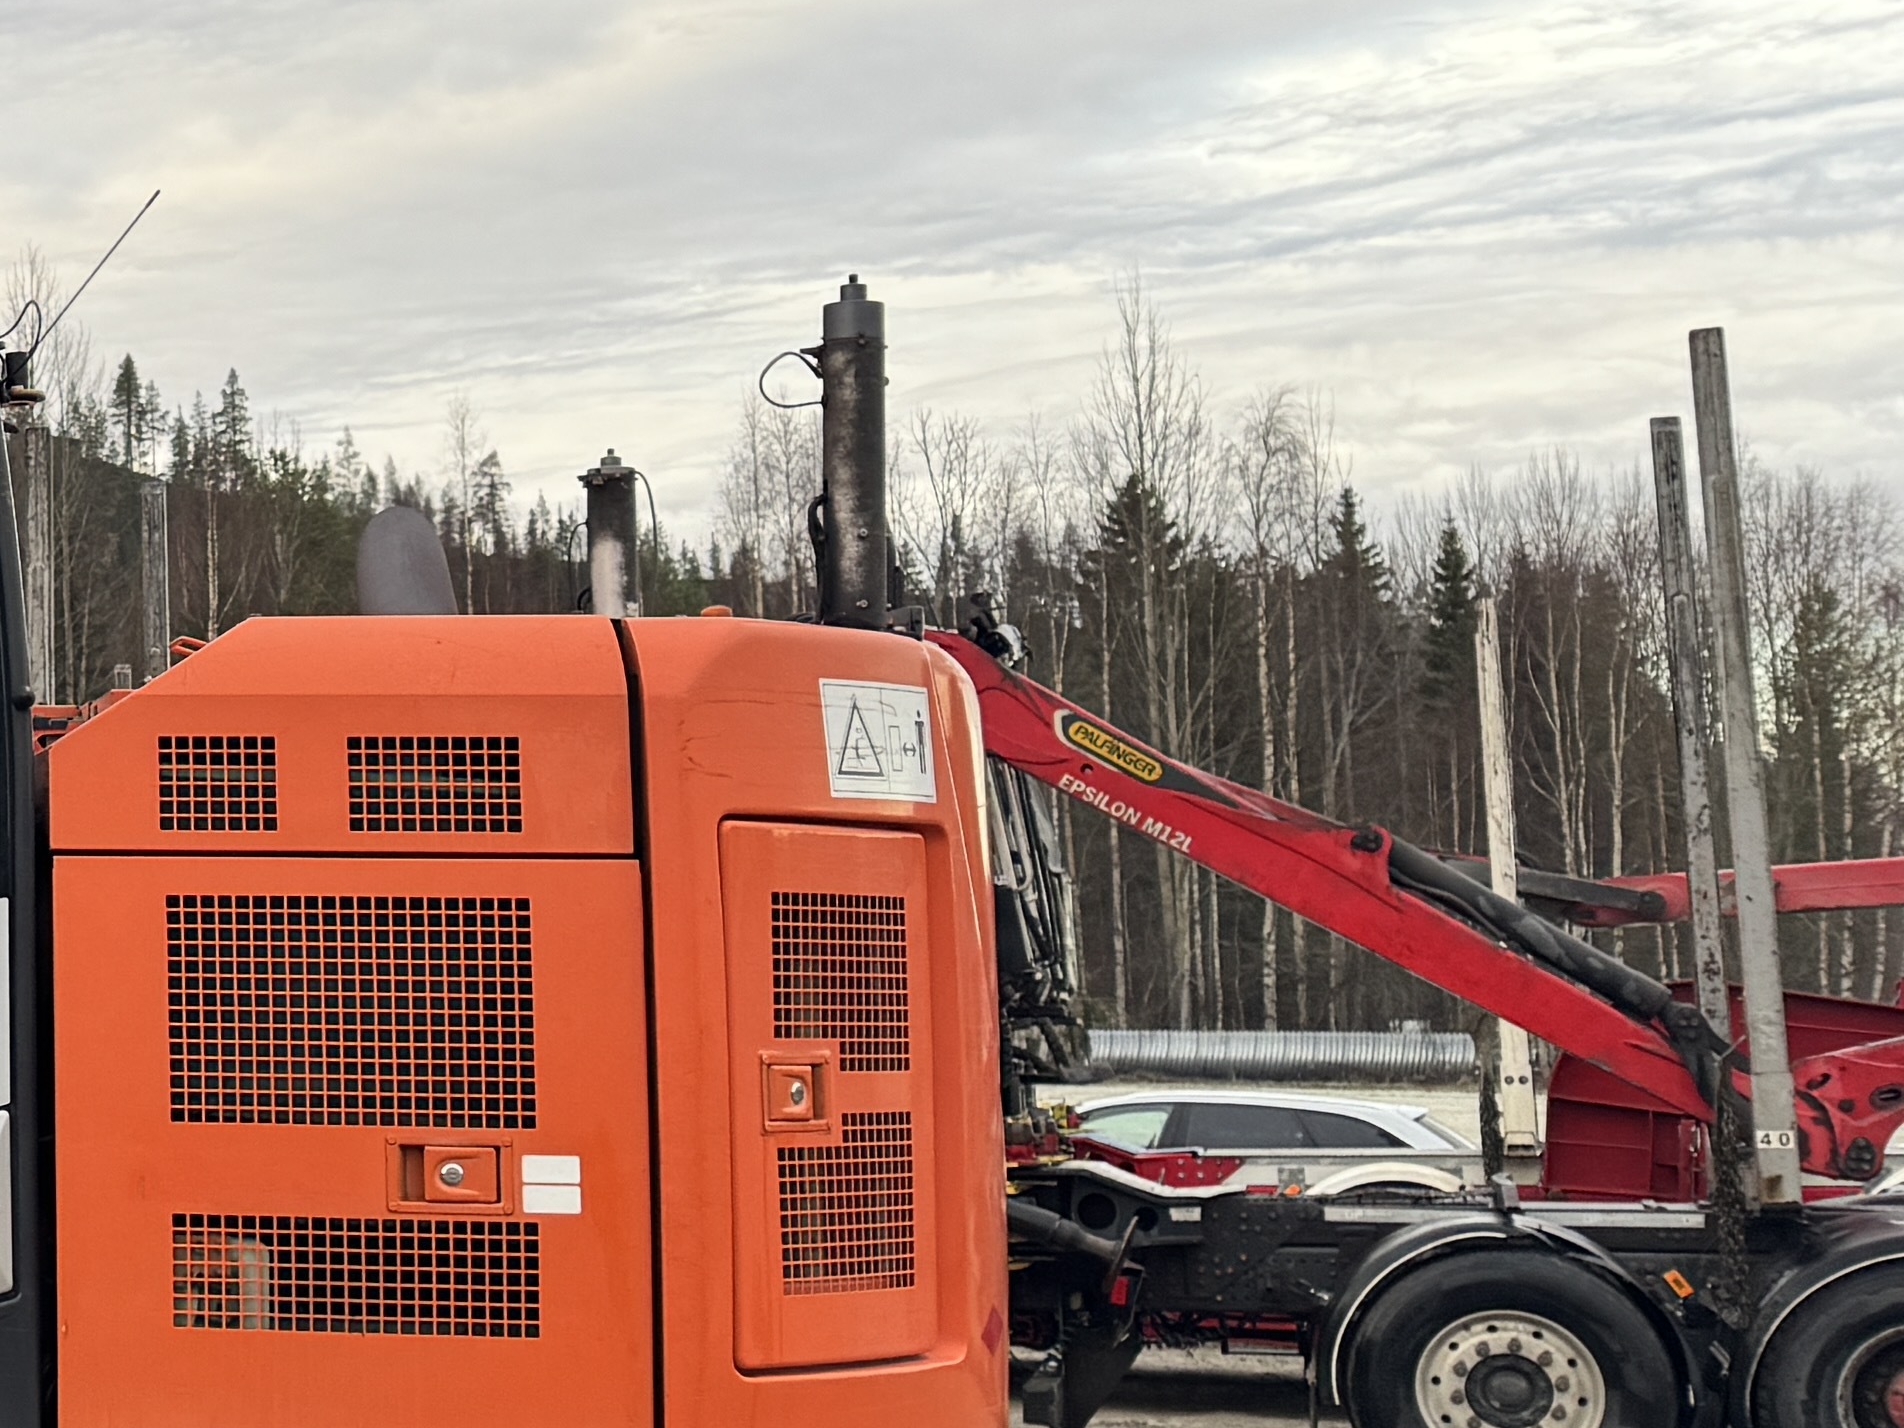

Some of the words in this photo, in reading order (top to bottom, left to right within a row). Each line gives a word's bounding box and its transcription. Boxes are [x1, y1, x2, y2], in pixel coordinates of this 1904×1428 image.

[1074, 724, 1158, 778] PALFINGER
[1058, 774, 1141, 825] EPSILON
[1142, 817, 1193, 853] M12L
